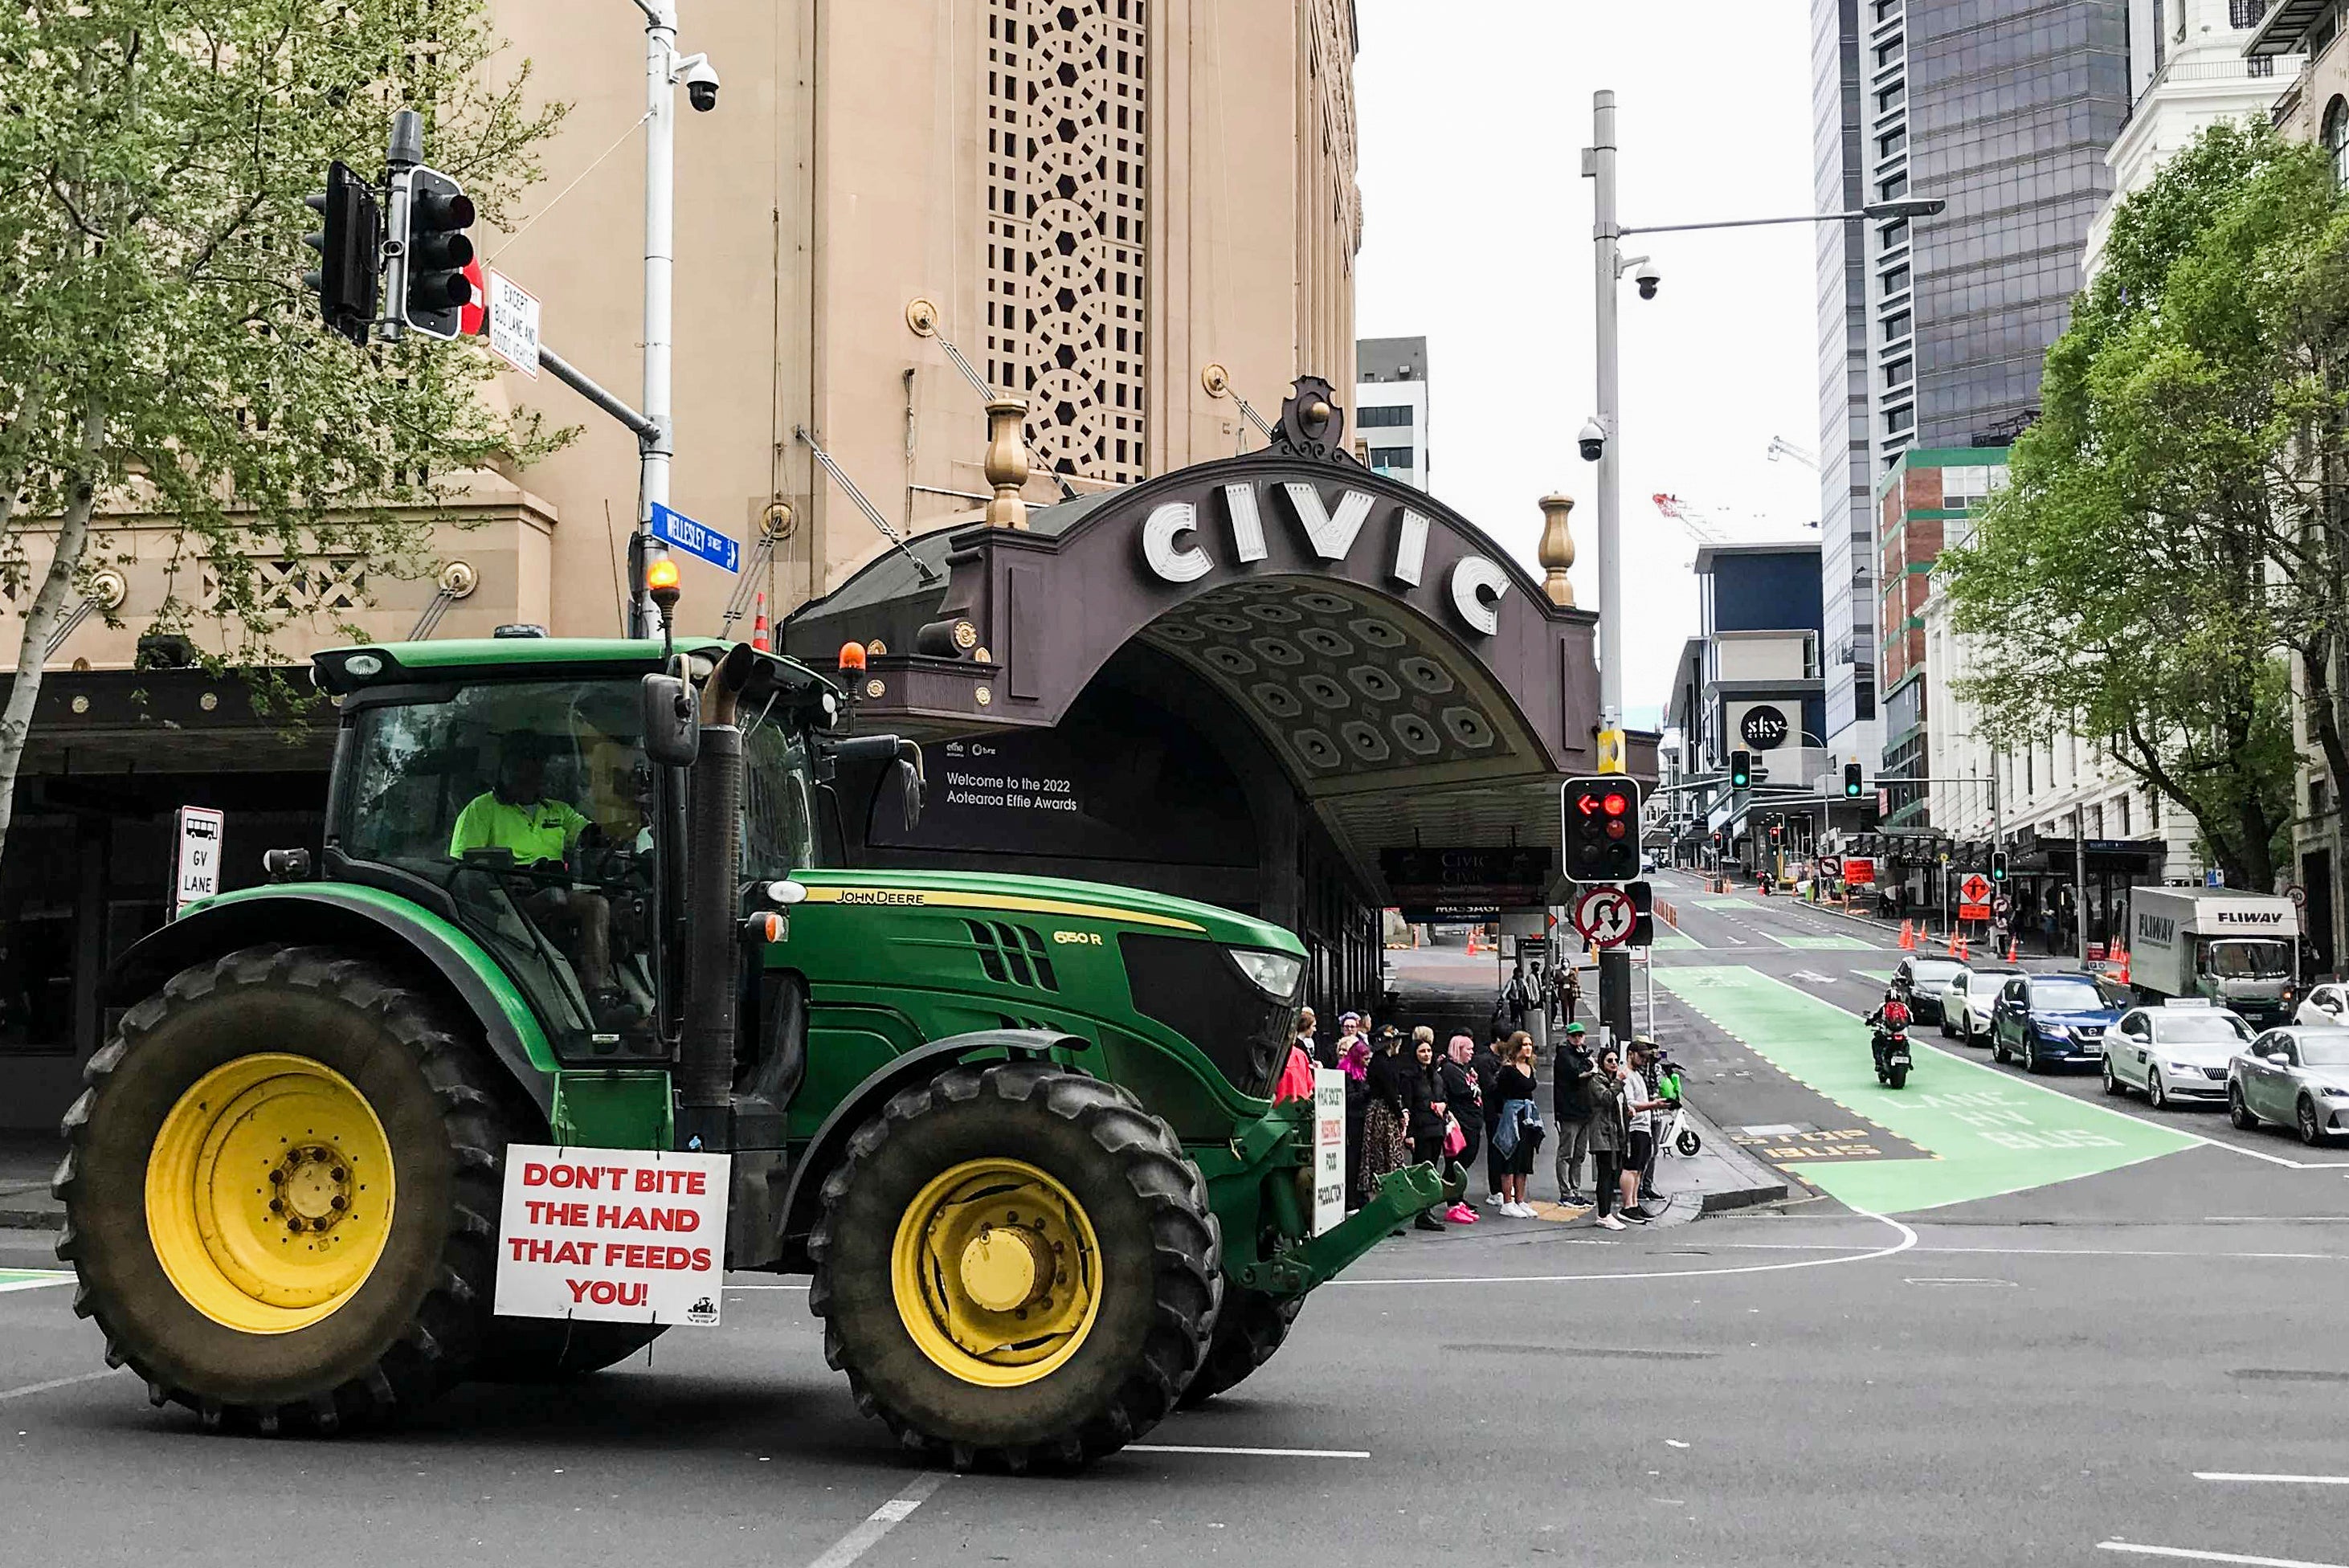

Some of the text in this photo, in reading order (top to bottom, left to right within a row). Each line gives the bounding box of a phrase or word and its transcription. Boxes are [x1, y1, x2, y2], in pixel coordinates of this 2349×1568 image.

[505, 284, 528, 315] EXCEPT
[495, 304, 506, 326] BUS
[666, 512, 706, 553] WELLESLEY
[1143, 482, 1511, 635] CIVIC
[946, 772, 1070, 793] Welcome to the 2022
[946, 790, 1077, 811] Aotearoa Effie Awards
[193, 850, 208, 867] GV
[184, 876, 212, 893] LANE
[836, 890, 925, 905] JOHN DEERE
[2139, 913, 2175, 943] FLIWAY
[2217, 913, 2283, 923] FLIWAY
[1730, 1129, 1869, 1145] STOP
[1976, 1129, 2126, 1149] BUS
[1763, 1144, 1882, 1158] BUS
[523, 1163, 706, 1195] DON'T BITE
[525, 1201, 701, 1232] THE HAND
[508, 1238, 712, 1271] THAT FEEDS
[566, 1279, 648, 1306] YOU!
